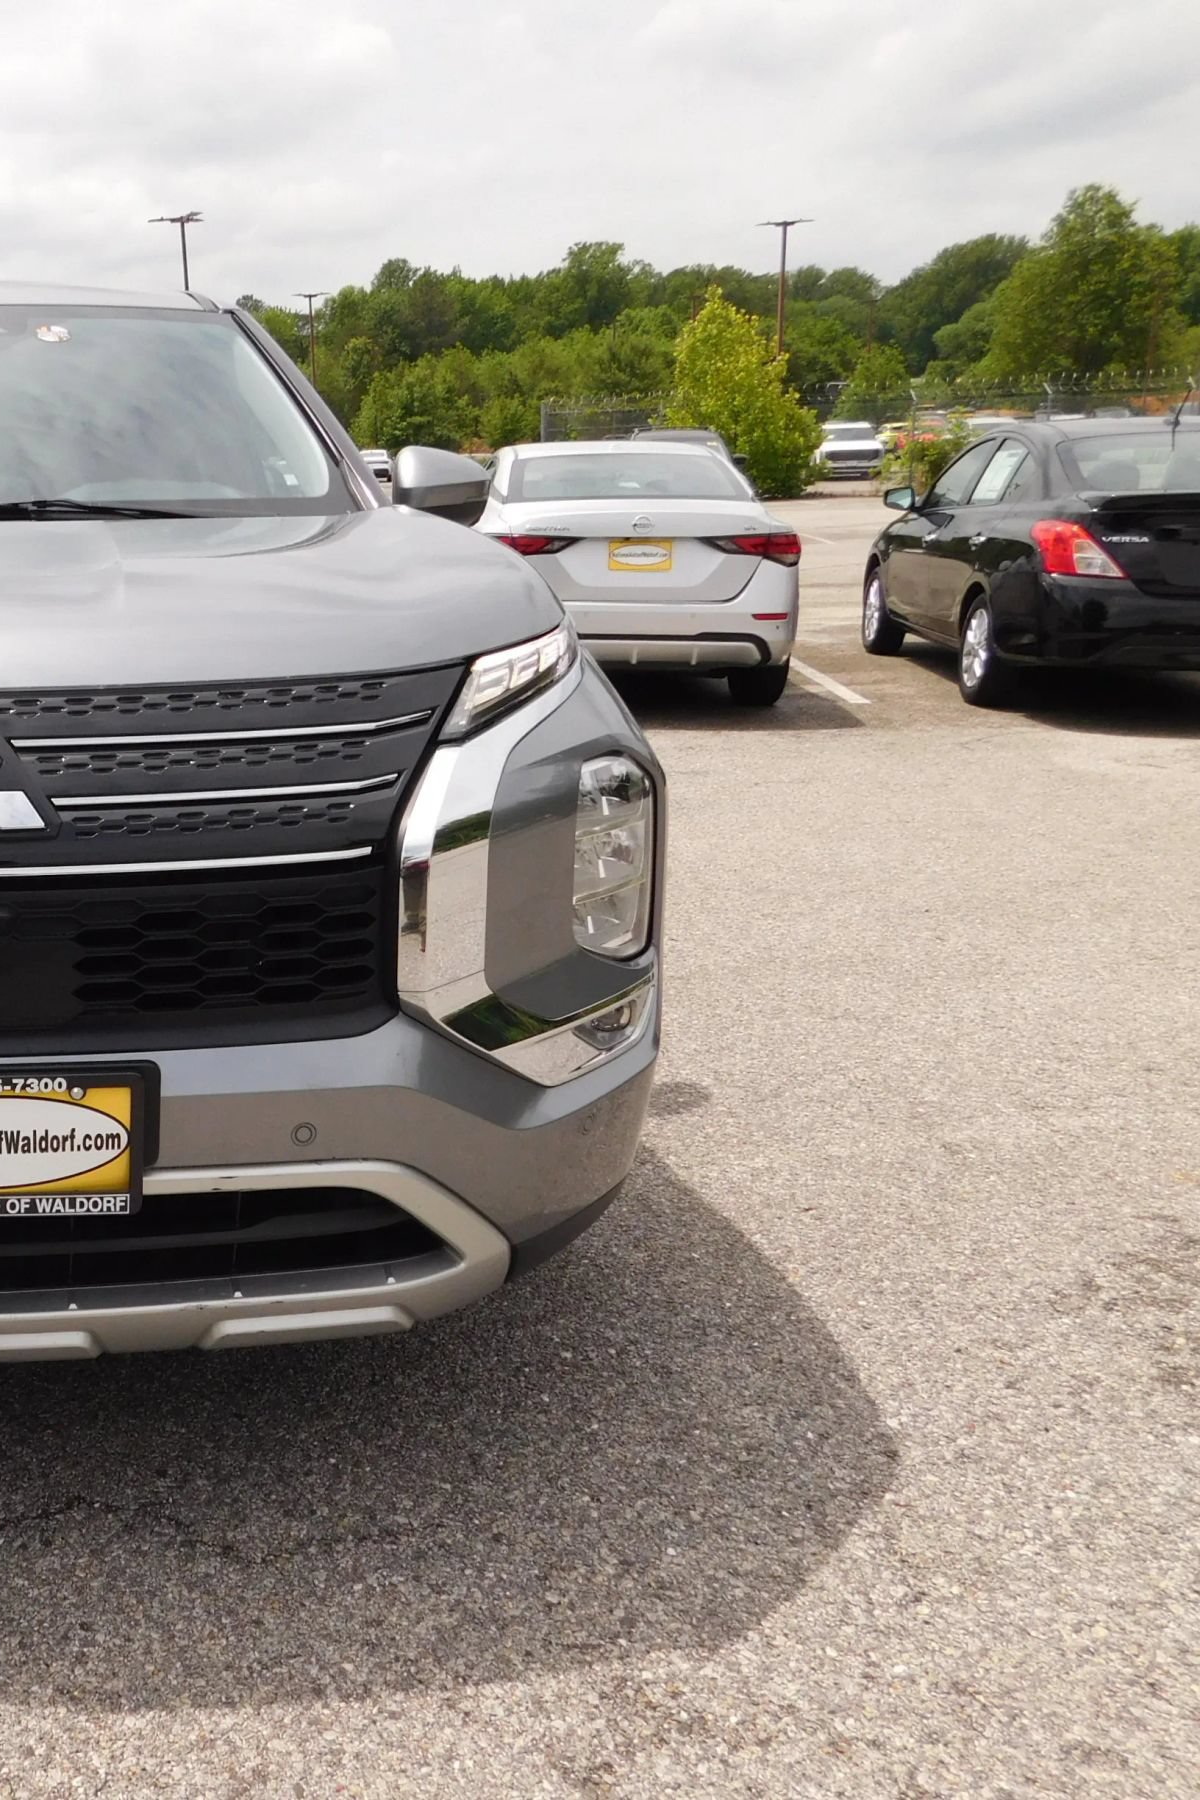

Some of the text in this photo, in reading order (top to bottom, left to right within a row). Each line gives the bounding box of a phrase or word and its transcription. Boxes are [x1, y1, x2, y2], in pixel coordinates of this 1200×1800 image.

[1101, 535, 1150, 543] VERSA
[7, 1199, 31, 1214] OF
[36, 1197, 127, 1214] WALDORF
